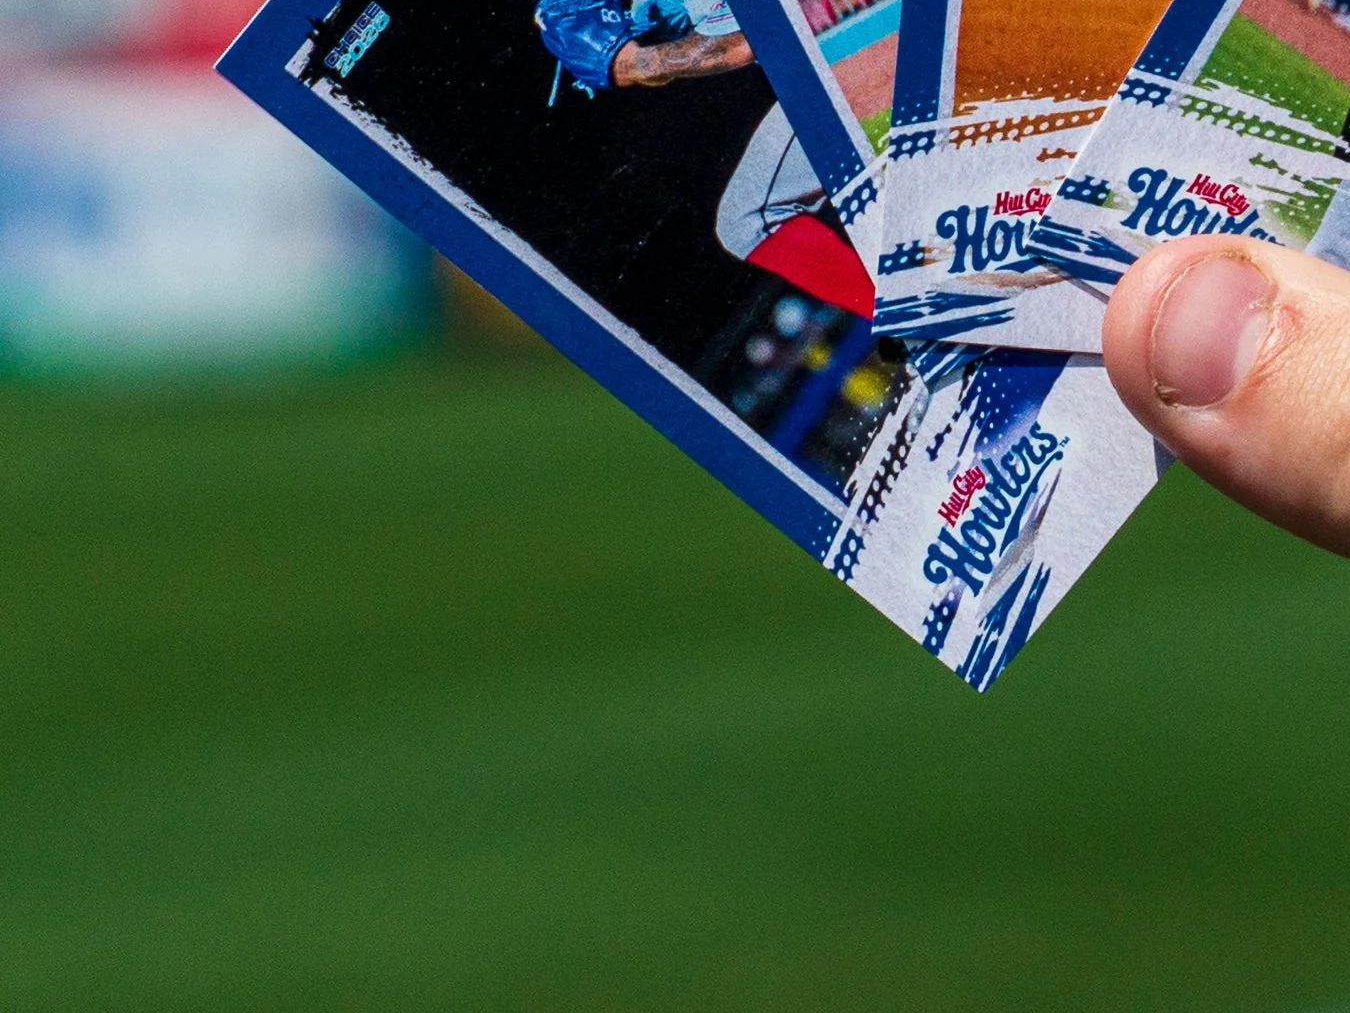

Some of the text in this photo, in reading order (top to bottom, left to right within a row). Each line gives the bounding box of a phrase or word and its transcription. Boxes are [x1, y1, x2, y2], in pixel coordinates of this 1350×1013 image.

[324, 1, 382, 69] CHOICE
[336, 9, 391, 78] 2026
[993, 191, 1024, 216] Hill
[1186, 172, 1250, 216] Hill City
[922, 421, 1059, 598] Howlers
[937, 465, 987, 528] Hill City
